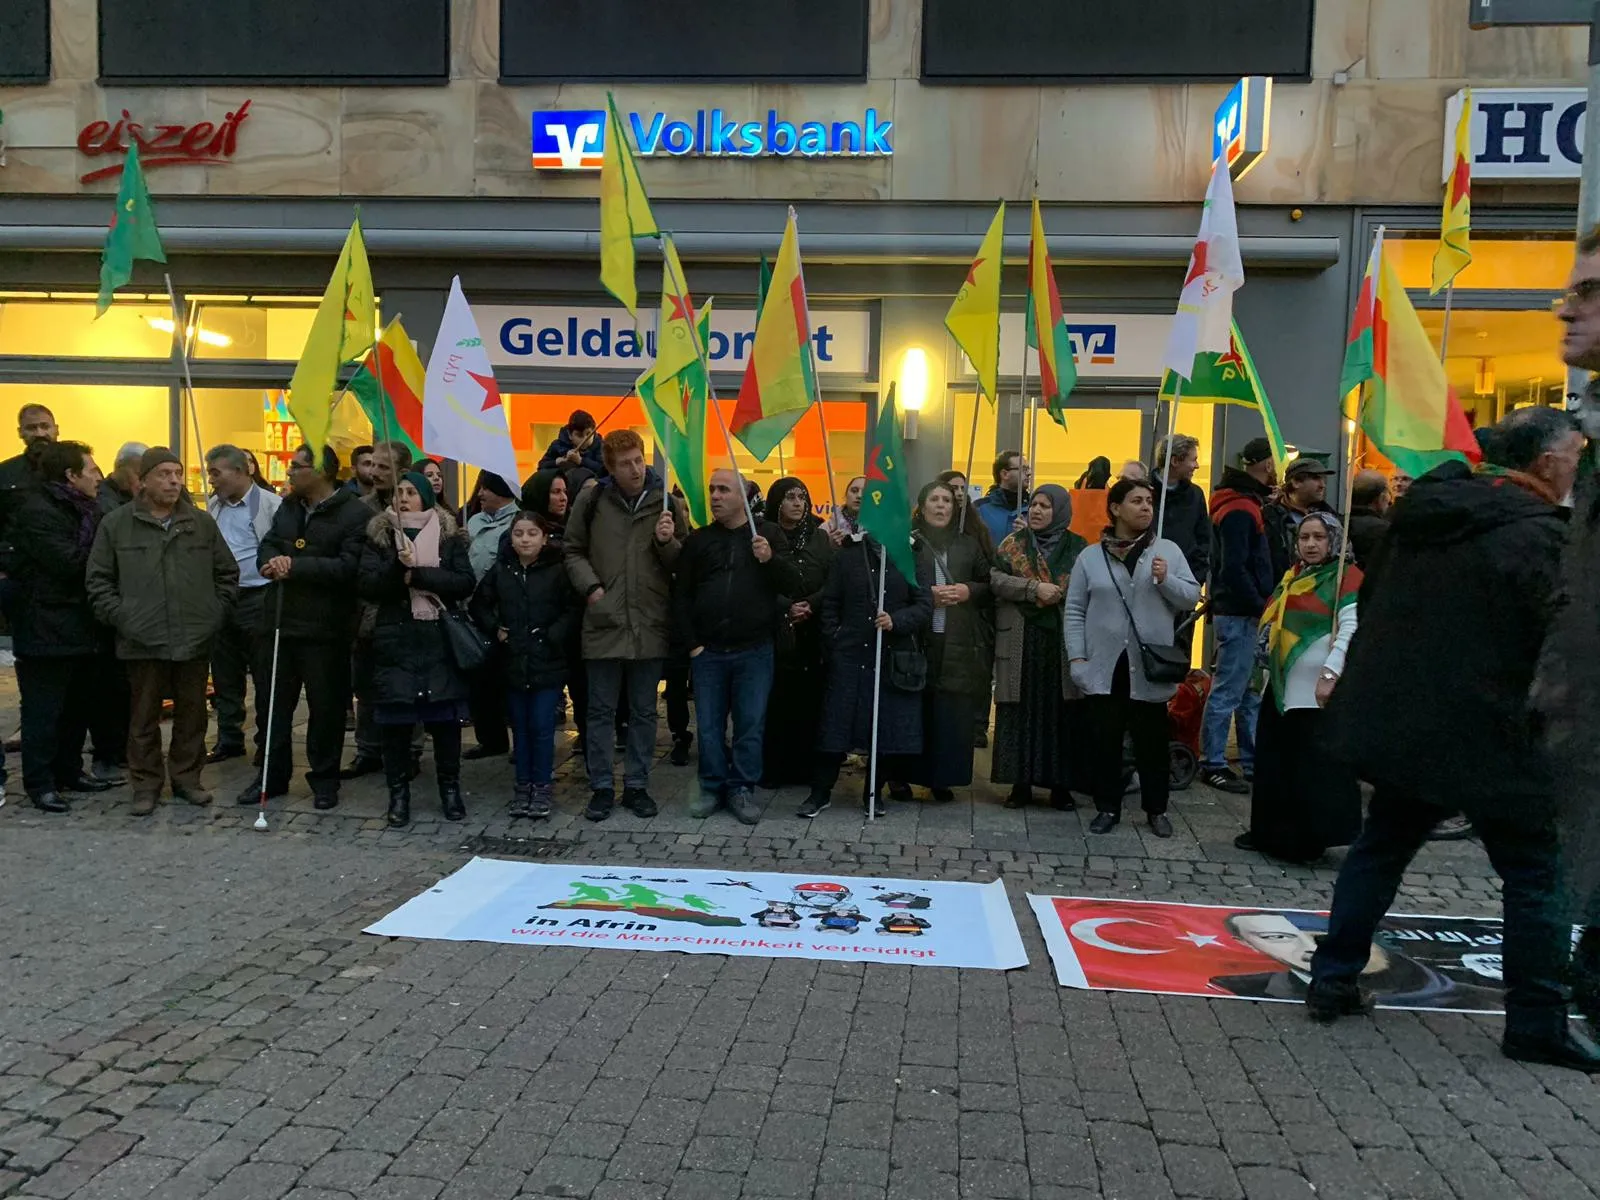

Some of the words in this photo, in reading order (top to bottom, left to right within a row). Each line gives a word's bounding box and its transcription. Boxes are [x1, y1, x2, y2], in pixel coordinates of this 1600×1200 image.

[77, 99, 252, 156] eiszeit
[629, 108, 893, 155] Volksbank
[500, 317, 833, 362] Geldaot
[511, 928, 568, 937] wird
[571, 929, 609, 939] die
[616, 932, 804, 949] Menschlichkeit
[811, 942, 937, 958] verteidigt
[525, 915, 559, 927] in
[566, 918, 658, 932] Afrin
